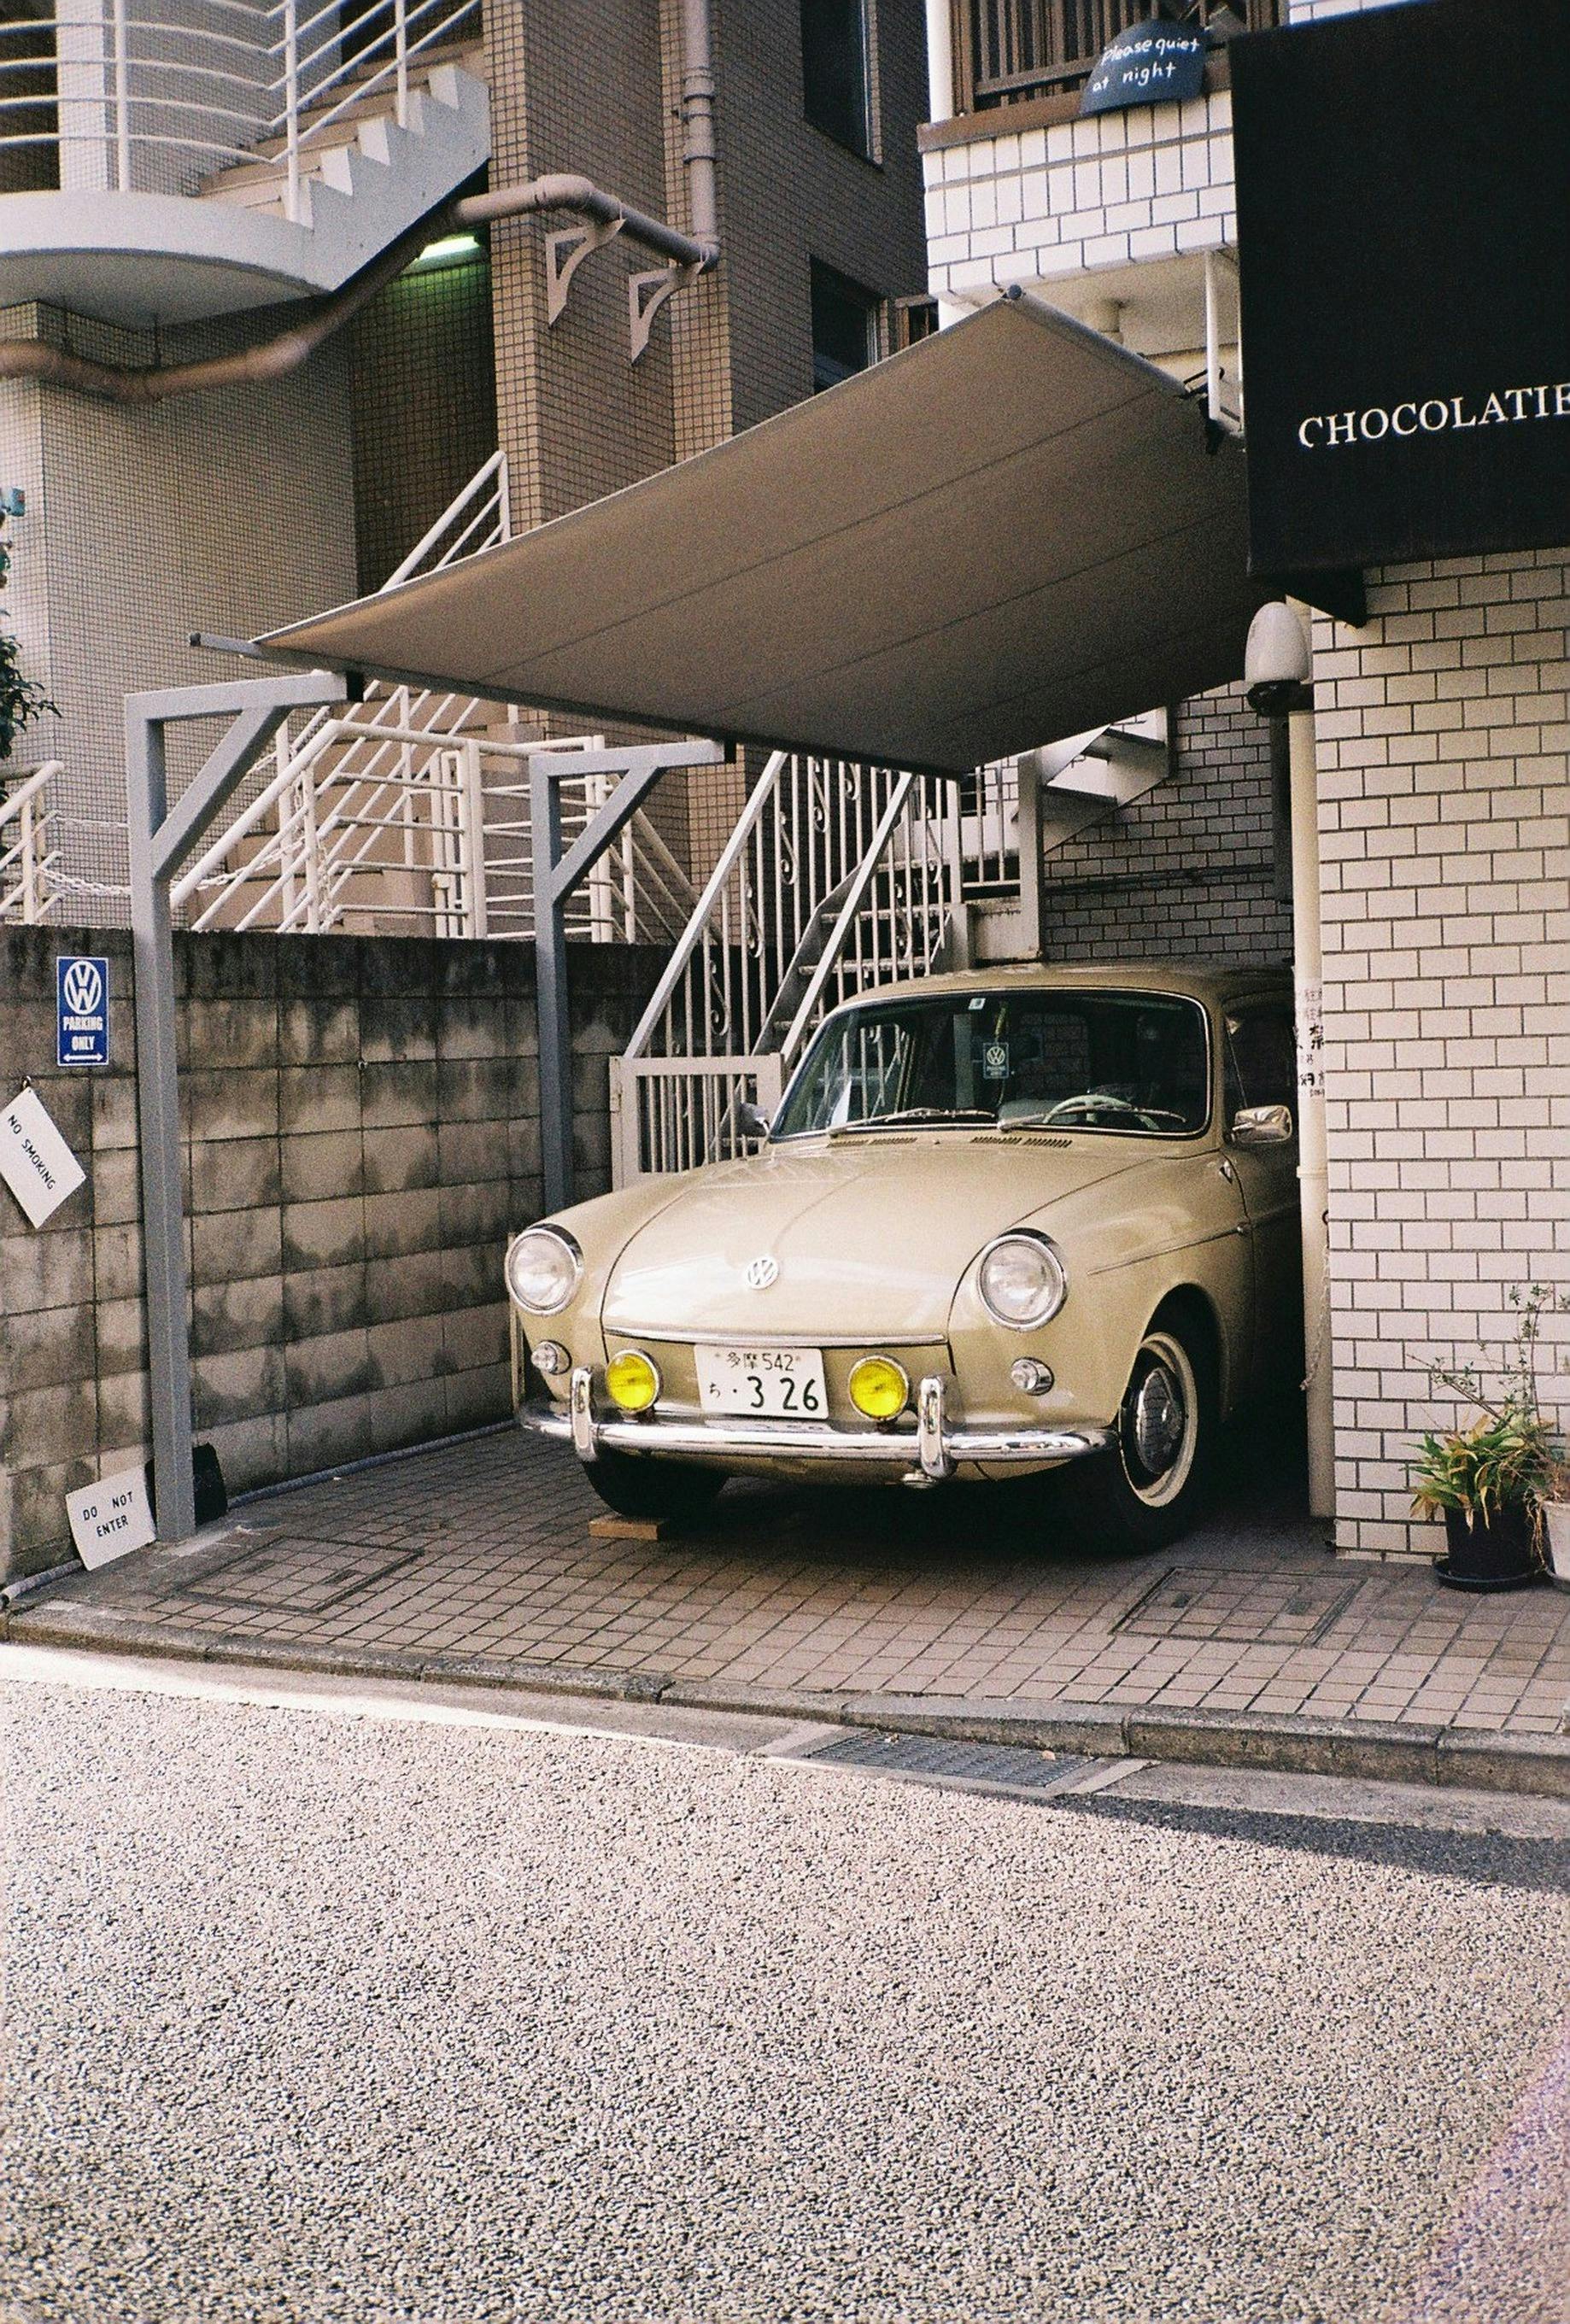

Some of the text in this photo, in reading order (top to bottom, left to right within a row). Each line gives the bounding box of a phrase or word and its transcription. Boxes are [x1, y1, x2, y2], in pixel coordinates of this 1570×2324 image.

[1100, 38, 1200, 66] please quiet
[1093, 61, 1177, 92] at night
[1298, 383, 1570, 448] CHOCOLATIE
[64, 960, 102, 1015] VW
[63, 1016, 103, 1031] PARKING
[71, 1035, 95, 1051] ONLY
[8, 1115, 56, 1190] NO SMOKING
[762, 1352, 794, 1372] 542
[83, 1491, 132, 1521] DO NOT
[97, 1514, 129, 1537] ENTER
